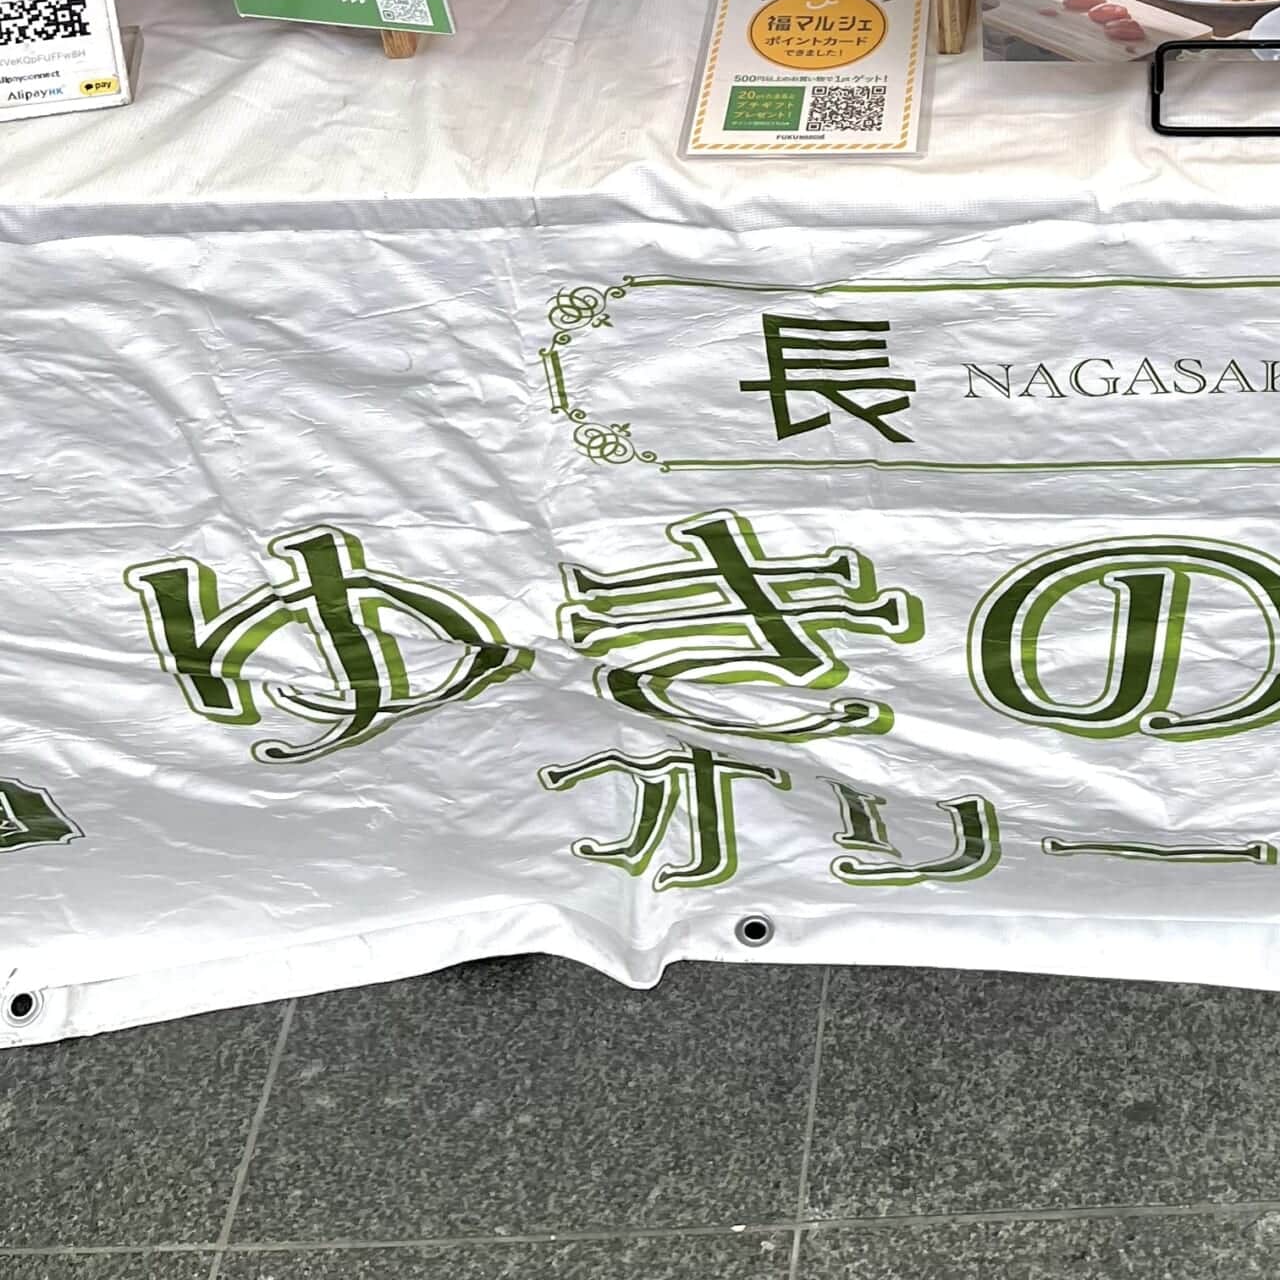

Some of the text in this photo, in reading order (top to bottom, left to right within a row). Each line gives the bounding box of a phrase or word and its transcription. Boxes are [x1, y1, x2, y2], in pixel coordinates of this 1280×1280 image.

[766, 14, 874, 33] 福マルシェ
[765, 36, 870, 48] ポイントカード
